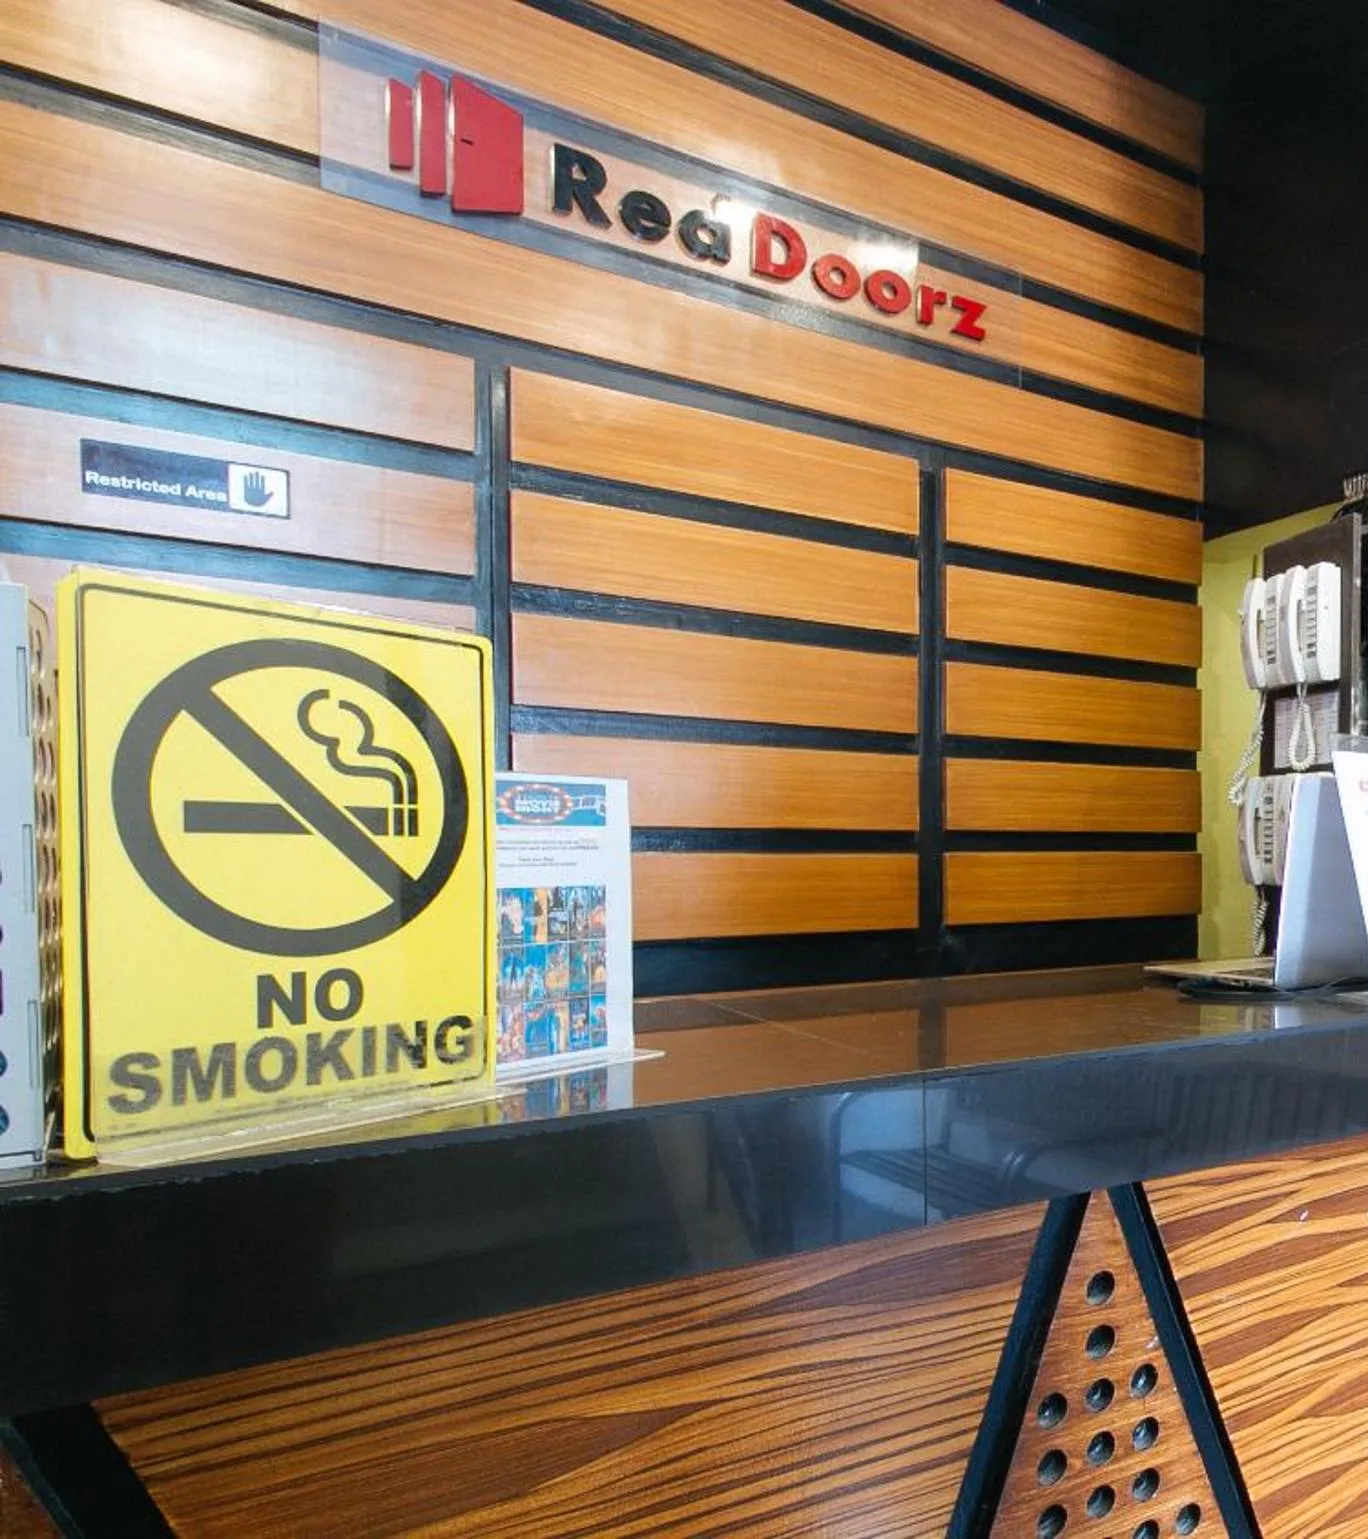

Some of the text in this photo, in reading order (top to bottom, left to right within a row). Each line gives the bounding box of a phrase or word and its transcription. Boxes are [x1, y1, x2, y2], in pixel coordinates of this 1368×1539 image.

[85, 470, 227, 502] Restricted Area
[256, 968, 364, 1029] NO
[107, 1015, 474, 1115] SMOKING
